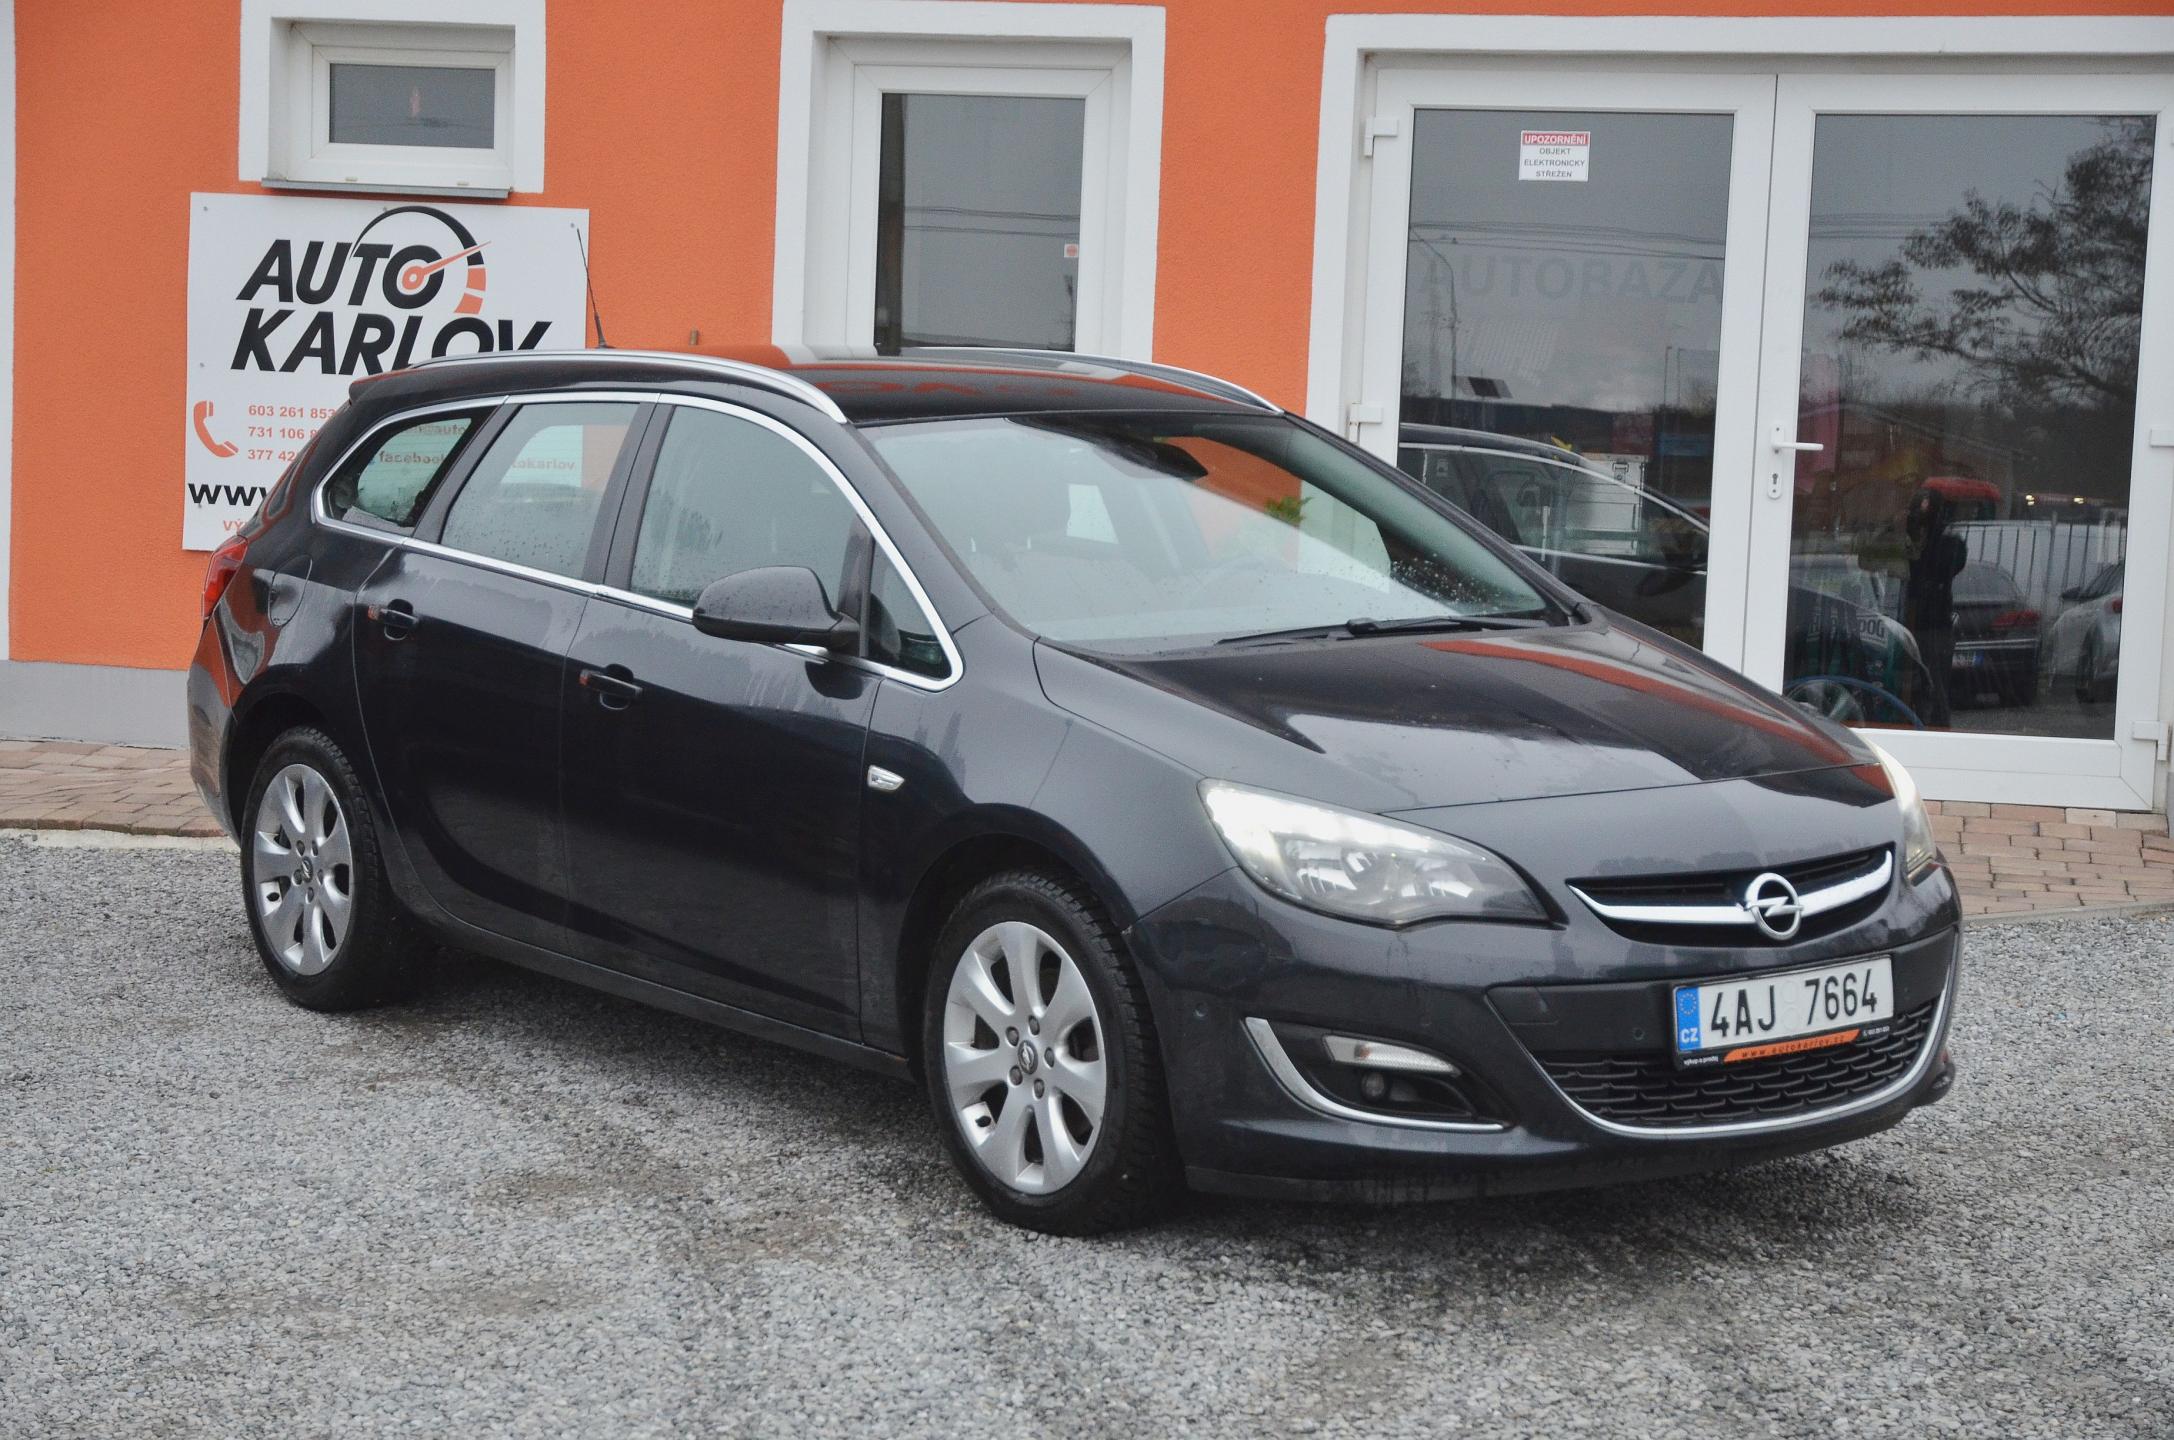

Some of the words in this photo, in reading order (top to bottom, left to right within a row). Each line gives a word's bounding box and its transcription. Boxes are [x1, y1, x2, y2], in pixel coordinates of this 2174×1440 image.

[1539, 147, 1570, 155] OBJEKT
[236, 239, 445, 310] AUTO
[248, 405, 274, 417] 603
[279, 406, 305, 418] 261
[248, 427, 273, 438] 731
[279, 428, 305, 439] 106
[248, 449, 273, 460] 377
[1710, 985, 1776, 1038] 4AJ
[1804, 968, 1878, 1026] 7664
[1680, 1027, 1699, 1044] CZ
